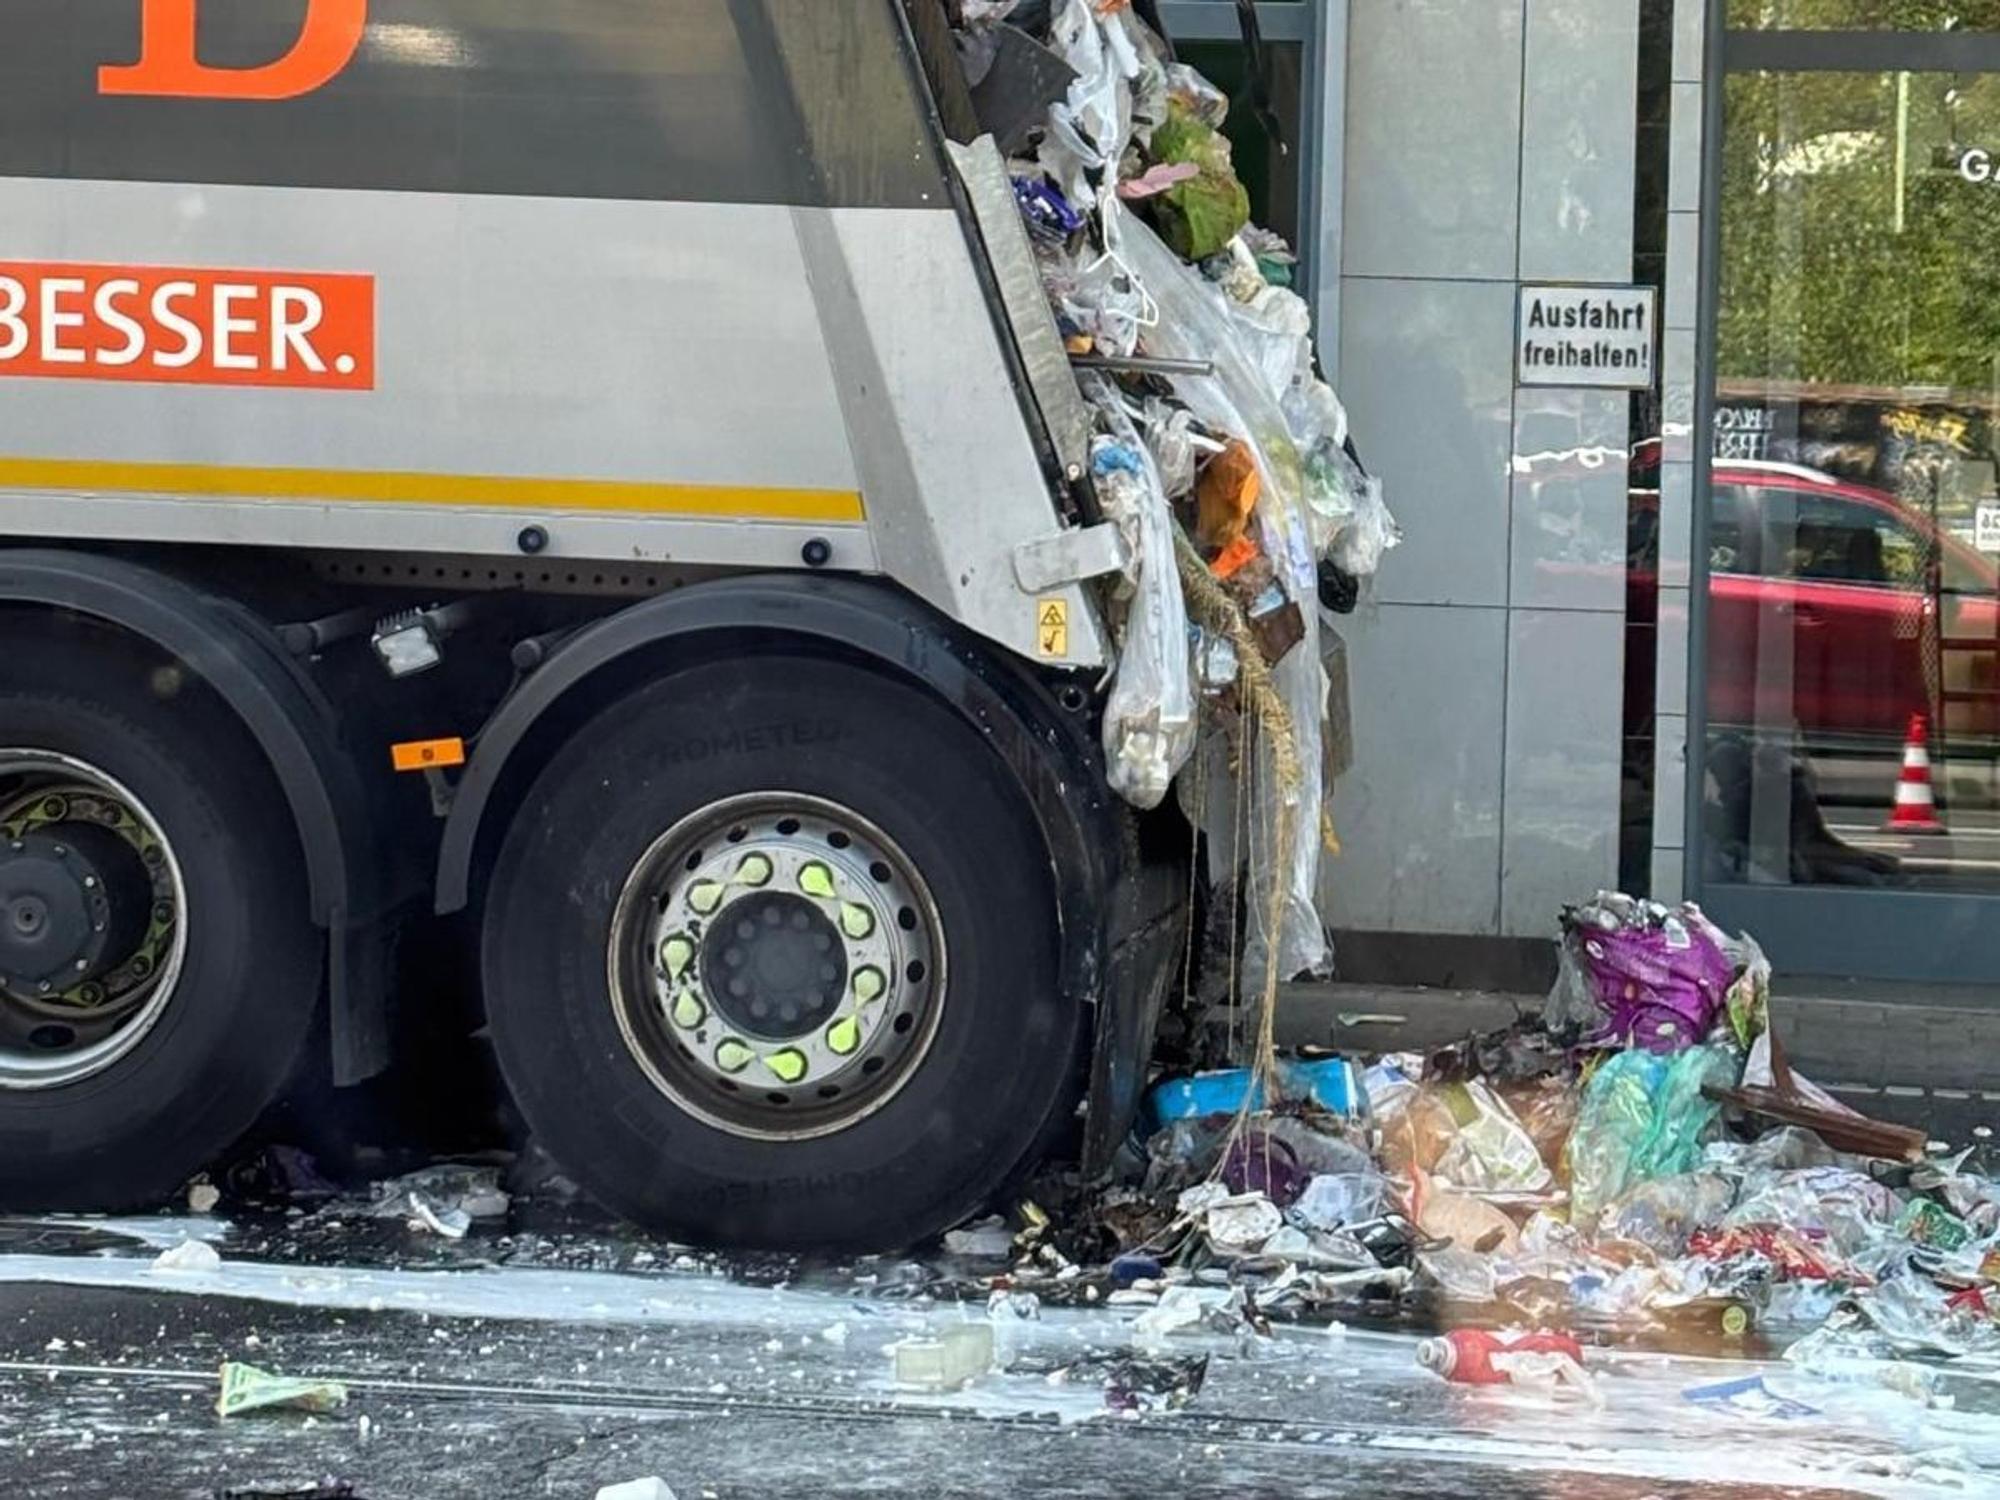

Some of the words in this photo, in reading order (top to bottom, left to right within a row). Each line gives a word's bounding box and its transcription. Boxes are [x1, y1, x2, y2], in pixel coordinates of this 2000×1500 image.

[0, 276, 356, 374] BESSER.
[1528, 299, 1645, 331] Ausfahrt
[1524, 339, 1648, 369] freihalten!
